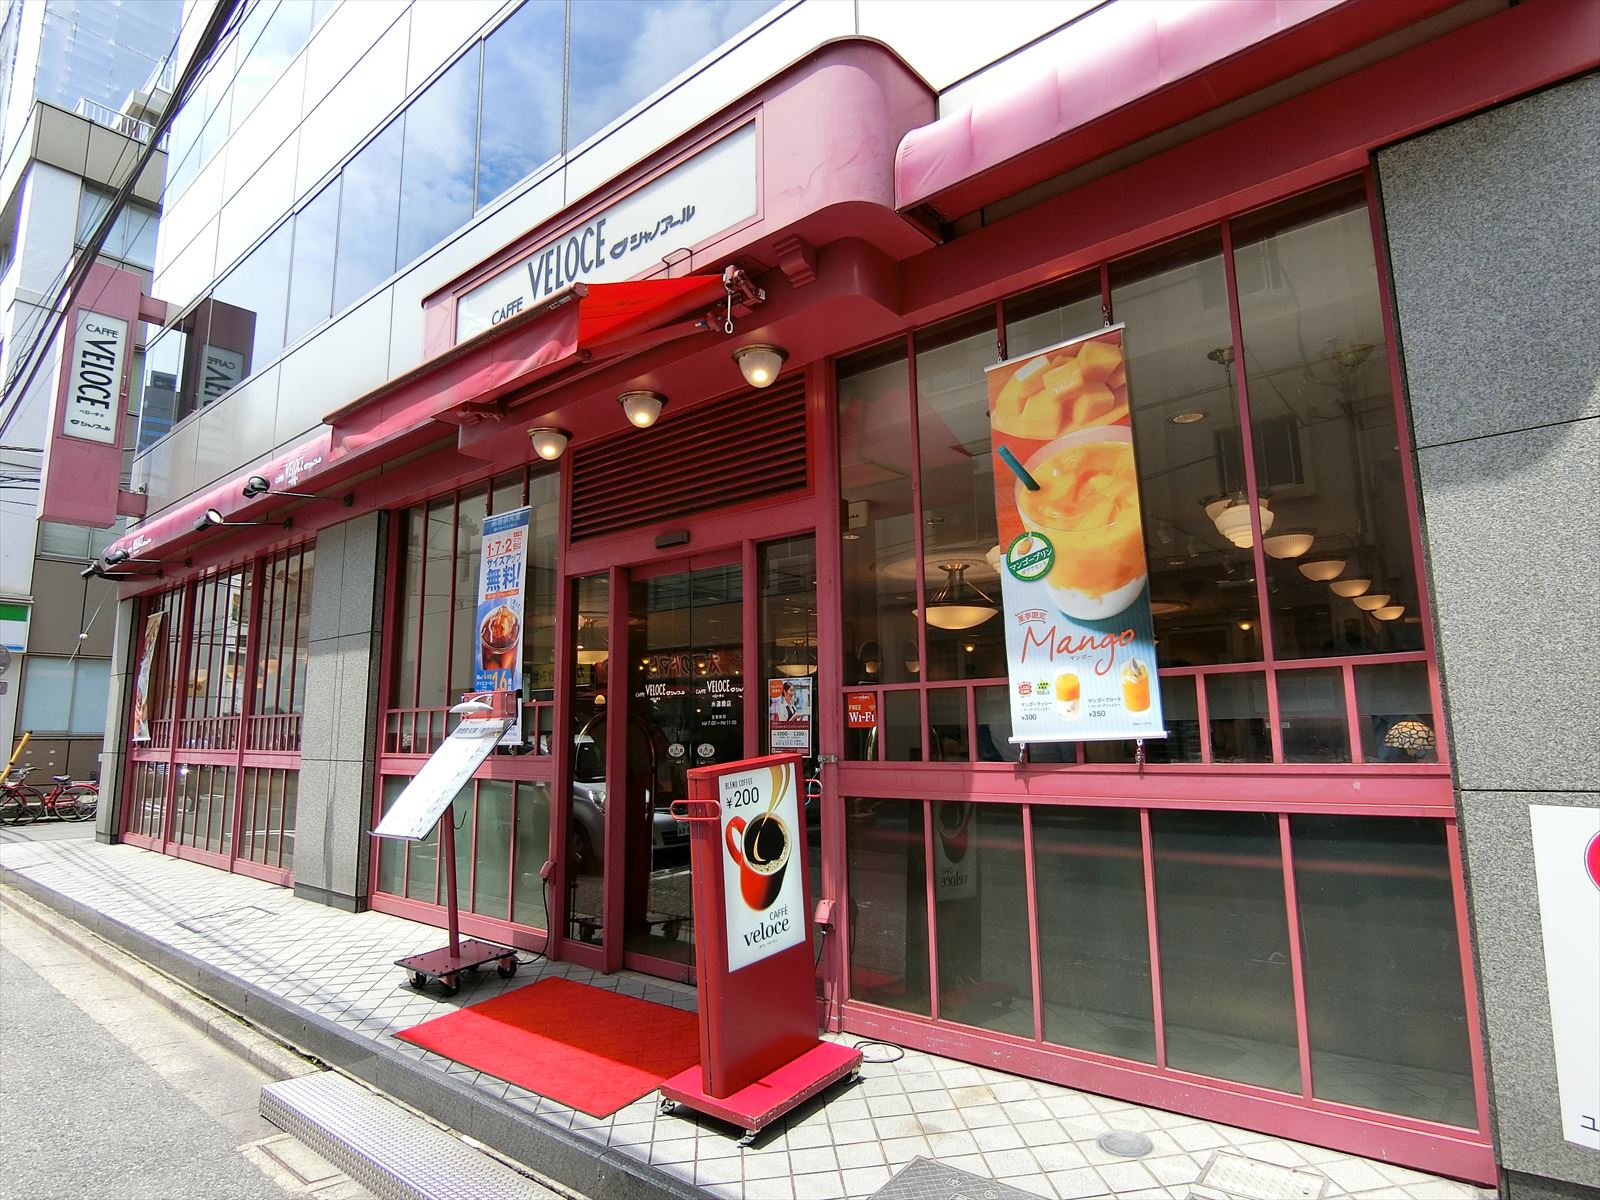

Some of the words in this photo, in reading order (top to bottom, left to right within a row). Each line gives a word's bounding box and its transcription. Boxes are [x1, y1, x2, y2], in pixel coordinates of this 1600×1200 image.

[492, 297, 524, 326] CAFFE
[528, 218, 606, 301] VELOCE
[85, 323, 120, 339] CAFFE
[76, 340, 117, 410] VELOCE
[486, 553, 522, 568] サイズアップ
[1010, 549, 1053, 571] マンゴープリン
[1017, 611, 1047, 623] 夏季限定
[1021, 625, 1135, 677] Mango
[645, 683, 667, 697] VELOCE
[706, 679, 731, 694] VELOCE
[725, 780, 738, 790] BLEND
[738, 777, 753, 786] COFFEE
[726, 786, 760, 810] ¥200
[743, 918, 791, 947] veloce
